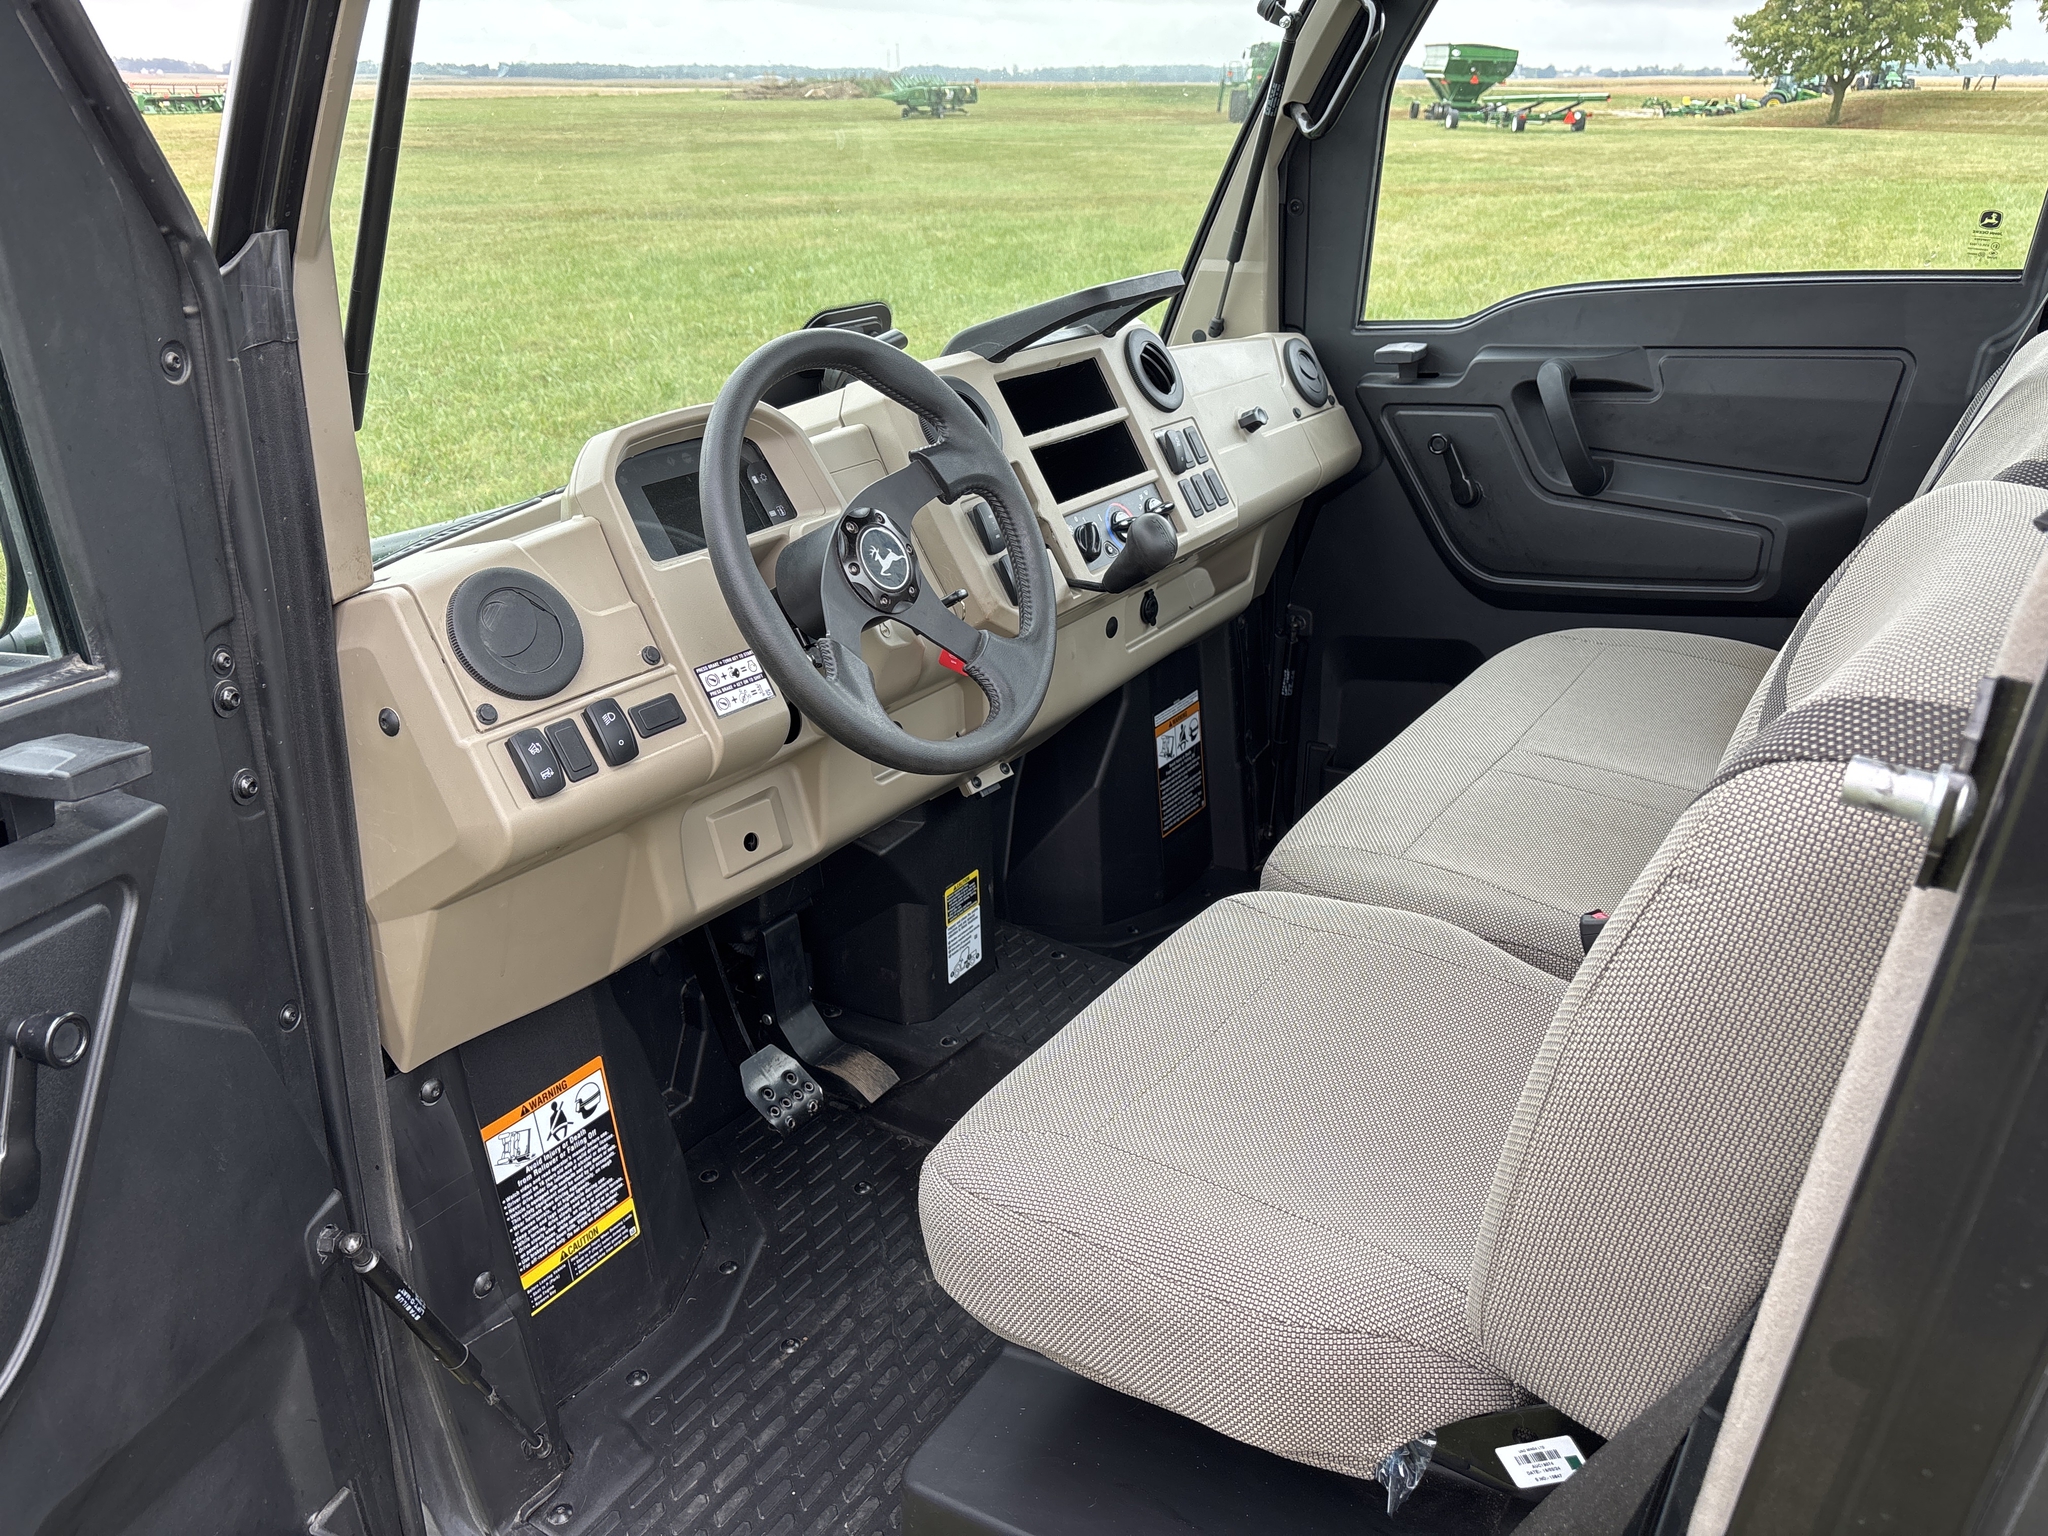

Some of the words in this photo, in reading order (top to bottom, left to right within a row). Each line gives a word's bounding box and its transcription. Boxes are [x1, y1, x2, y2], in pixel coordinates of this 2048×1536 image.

[528, 1079, 567, 1110] WARNING
[517, 1174, 532, 1185] from
[533, 1156, 557, 1175] Rollover
[567, 1137, 586, 1153] Falling
[588, 1129, 596, 1138] Off
[526, 1158, 542, 1172] Avoid
[543, 1146, 560, 1160] Injury
[569, 1129, 586, 1143] Death
[567, 1225, 599, 1255] CAUTION
[394, 1293, 421, 1321] STABILUS
